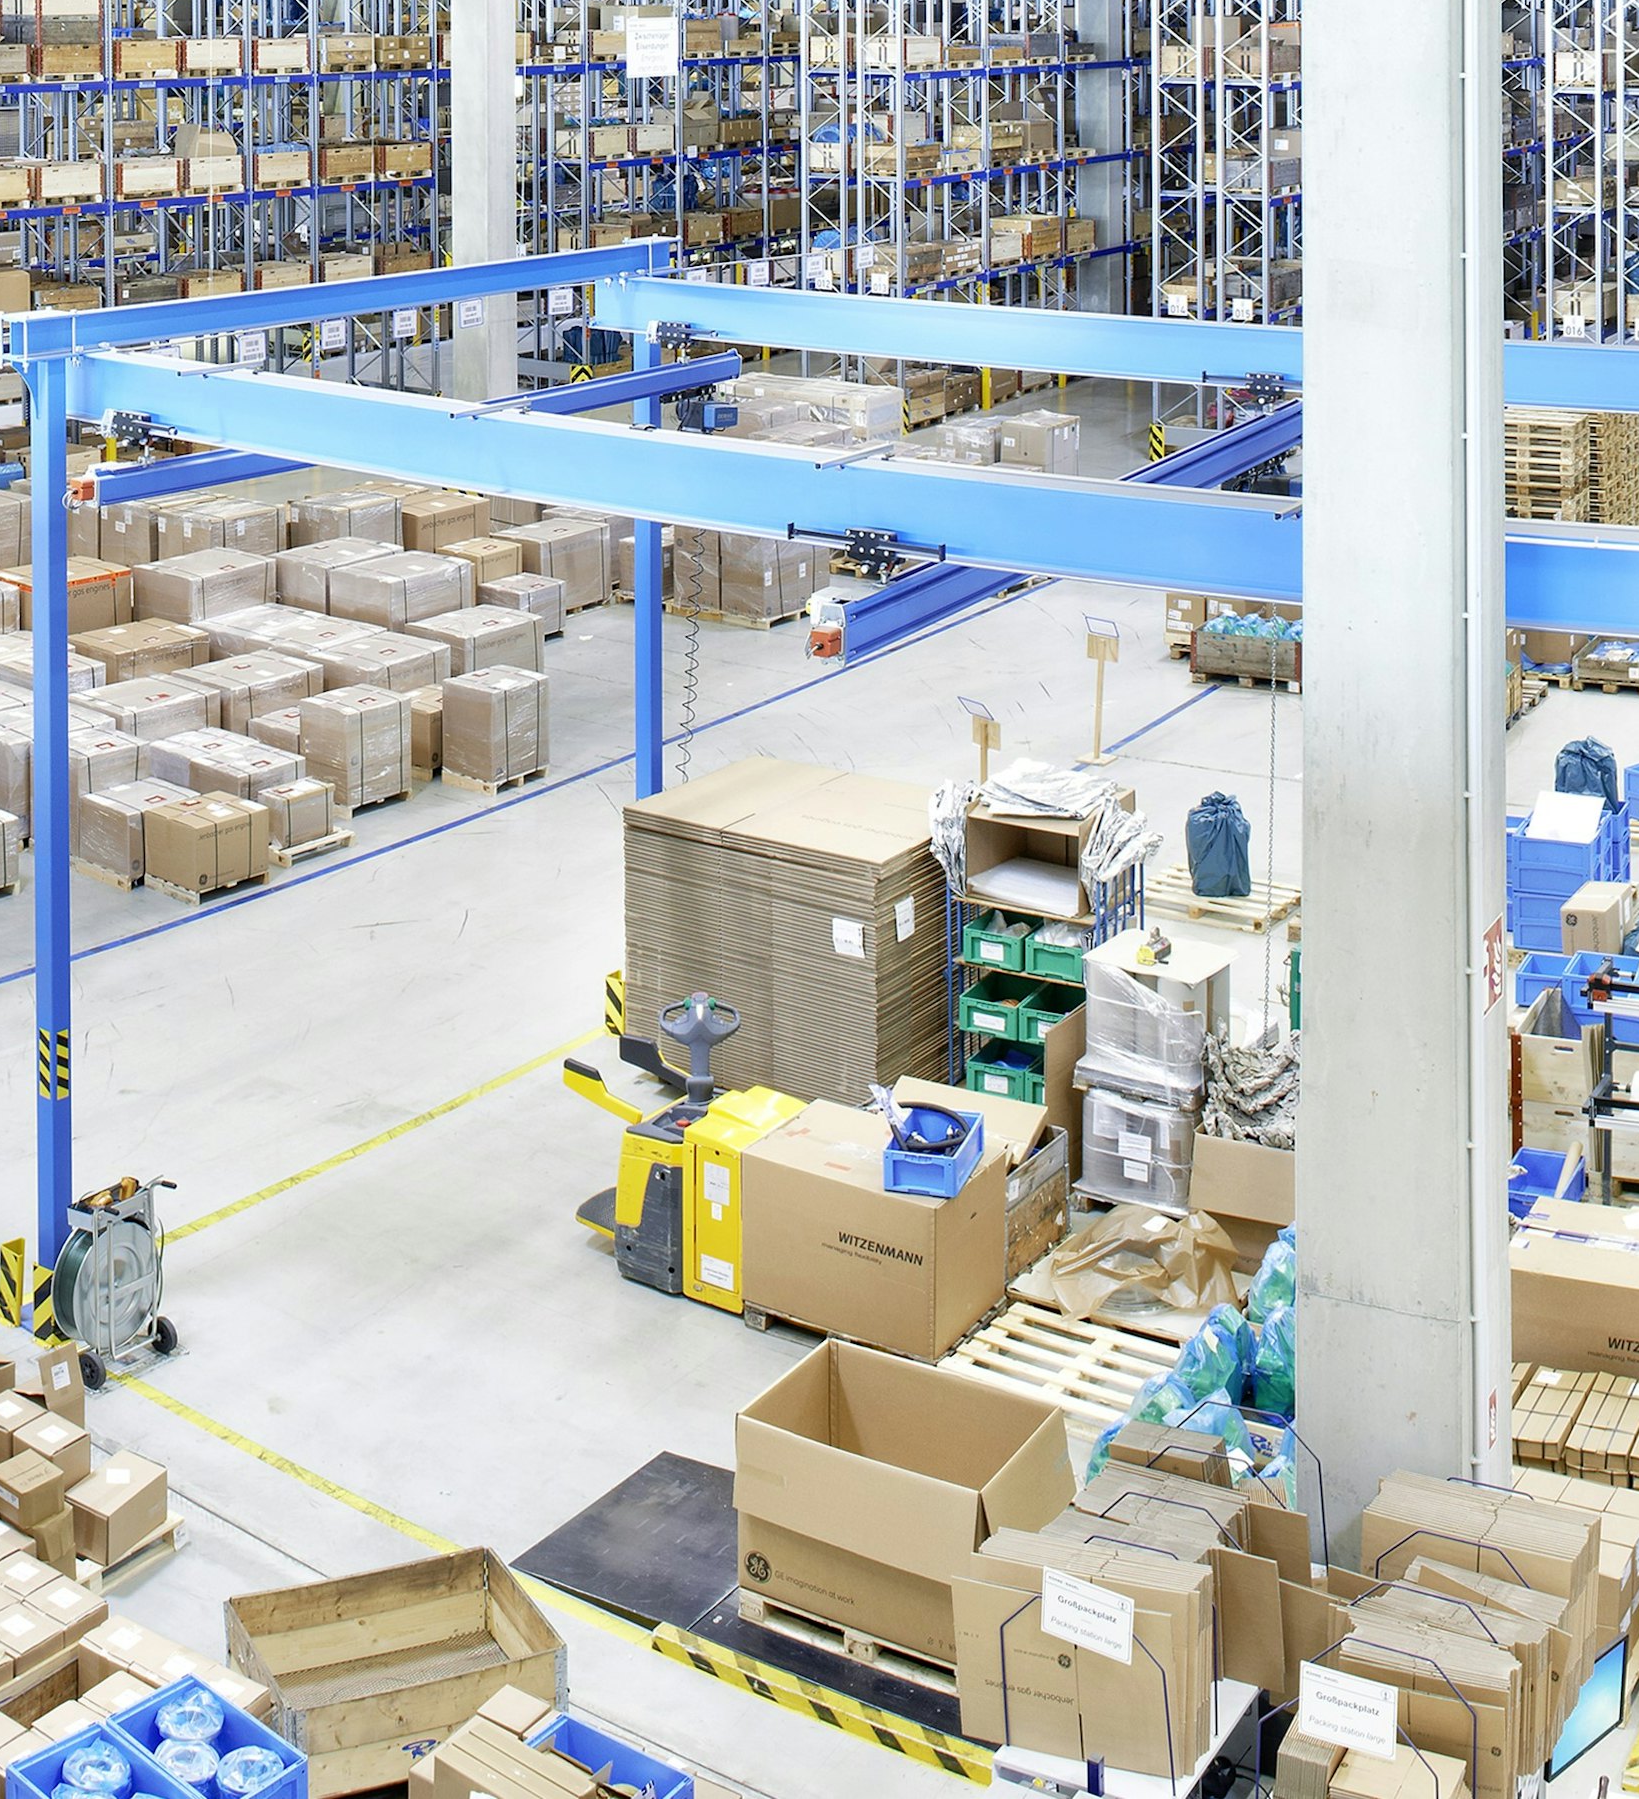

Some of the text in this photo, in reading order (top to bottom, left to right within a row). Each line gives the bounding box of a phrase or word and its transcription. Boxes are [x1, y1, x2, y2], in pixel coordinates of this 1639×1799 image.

[1170, 304, 1186, 314] 014
[1234, 309, 1251, 318] 015
[1566, 326, 1582, 336] 016
[72, 584, 110, 598] gas engines
[838, 1231, 924, 1266] WITZENMANN
[774, 1570, 786, 1580] GE
[788, 1574, 827, 1595] imagination
[836, 1594, 855, 1605] work
[1058, 1594, 1118, 1624] Großpackplatz
[1050, 1616, 1122, 1650] Packing station large
[1016, 1686, 1032, 1697] gas
[1034, 1690, 1074, 1706] Jenbacher
[1316, 1690, 1380, 1716] Großpackplatz
[1308, 1714, 1386, 1745] Packing station large
